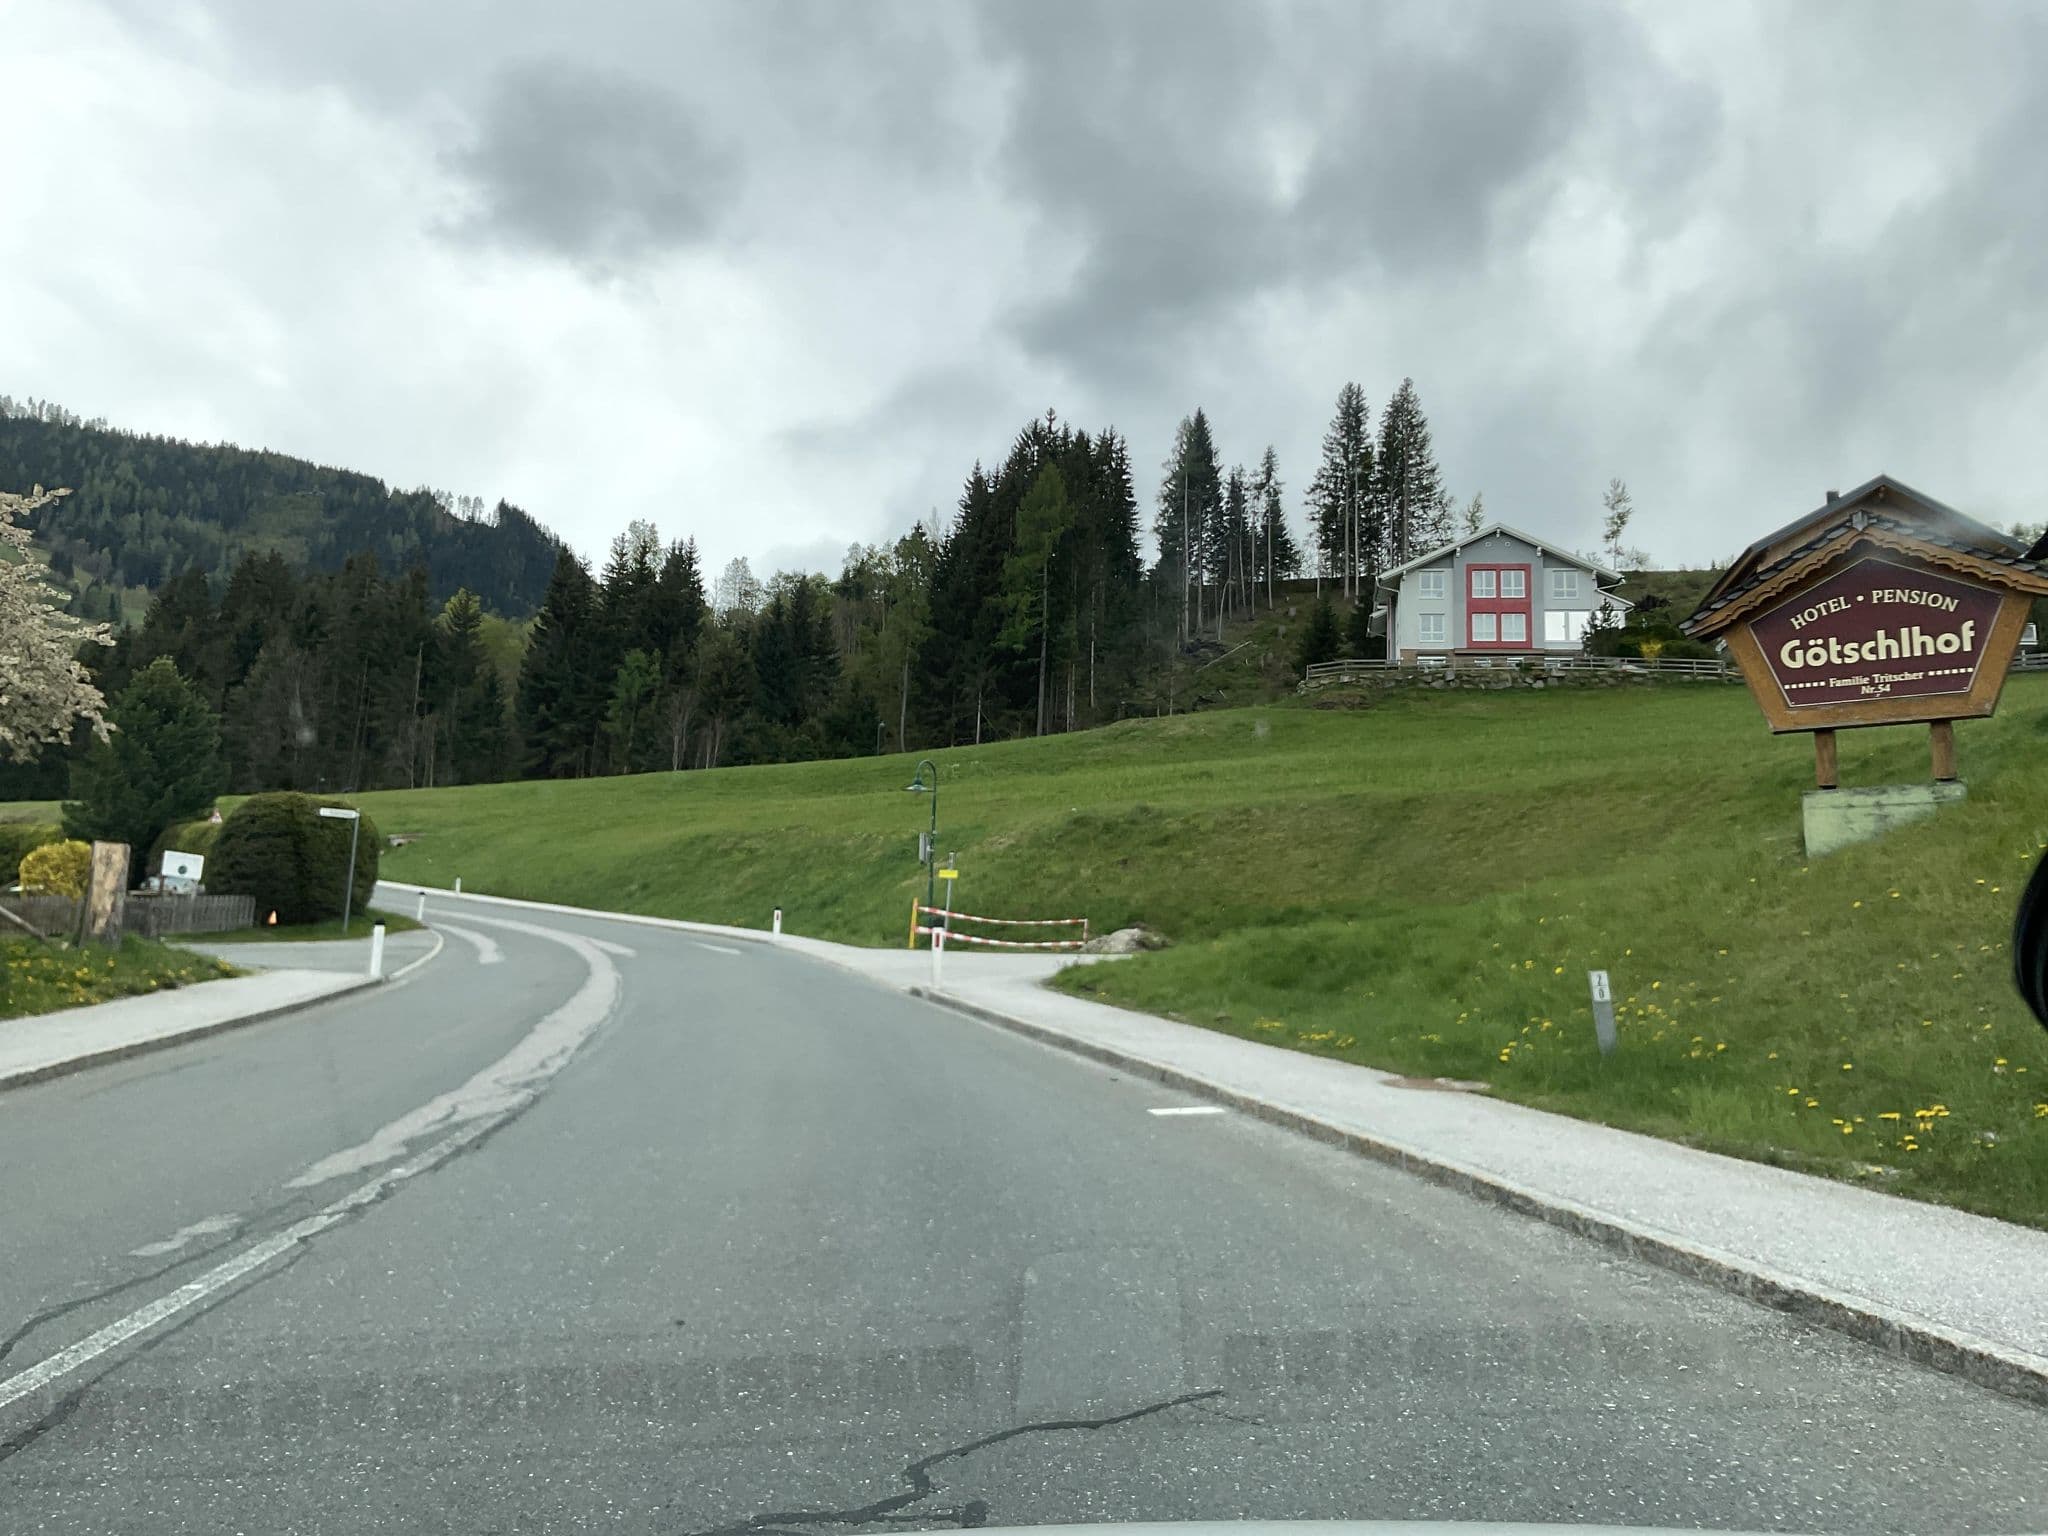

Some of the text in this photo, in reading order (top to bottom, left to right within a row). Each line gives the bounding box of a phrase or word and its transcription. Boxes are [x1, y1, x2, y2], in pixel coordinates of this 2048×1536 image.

[1789, 589, 1960, 630] HOTEL PENSION
[1780, 620, 1975, 669] Götschlhof
[1829, 671, 1924, 687] Familie Tritscher
